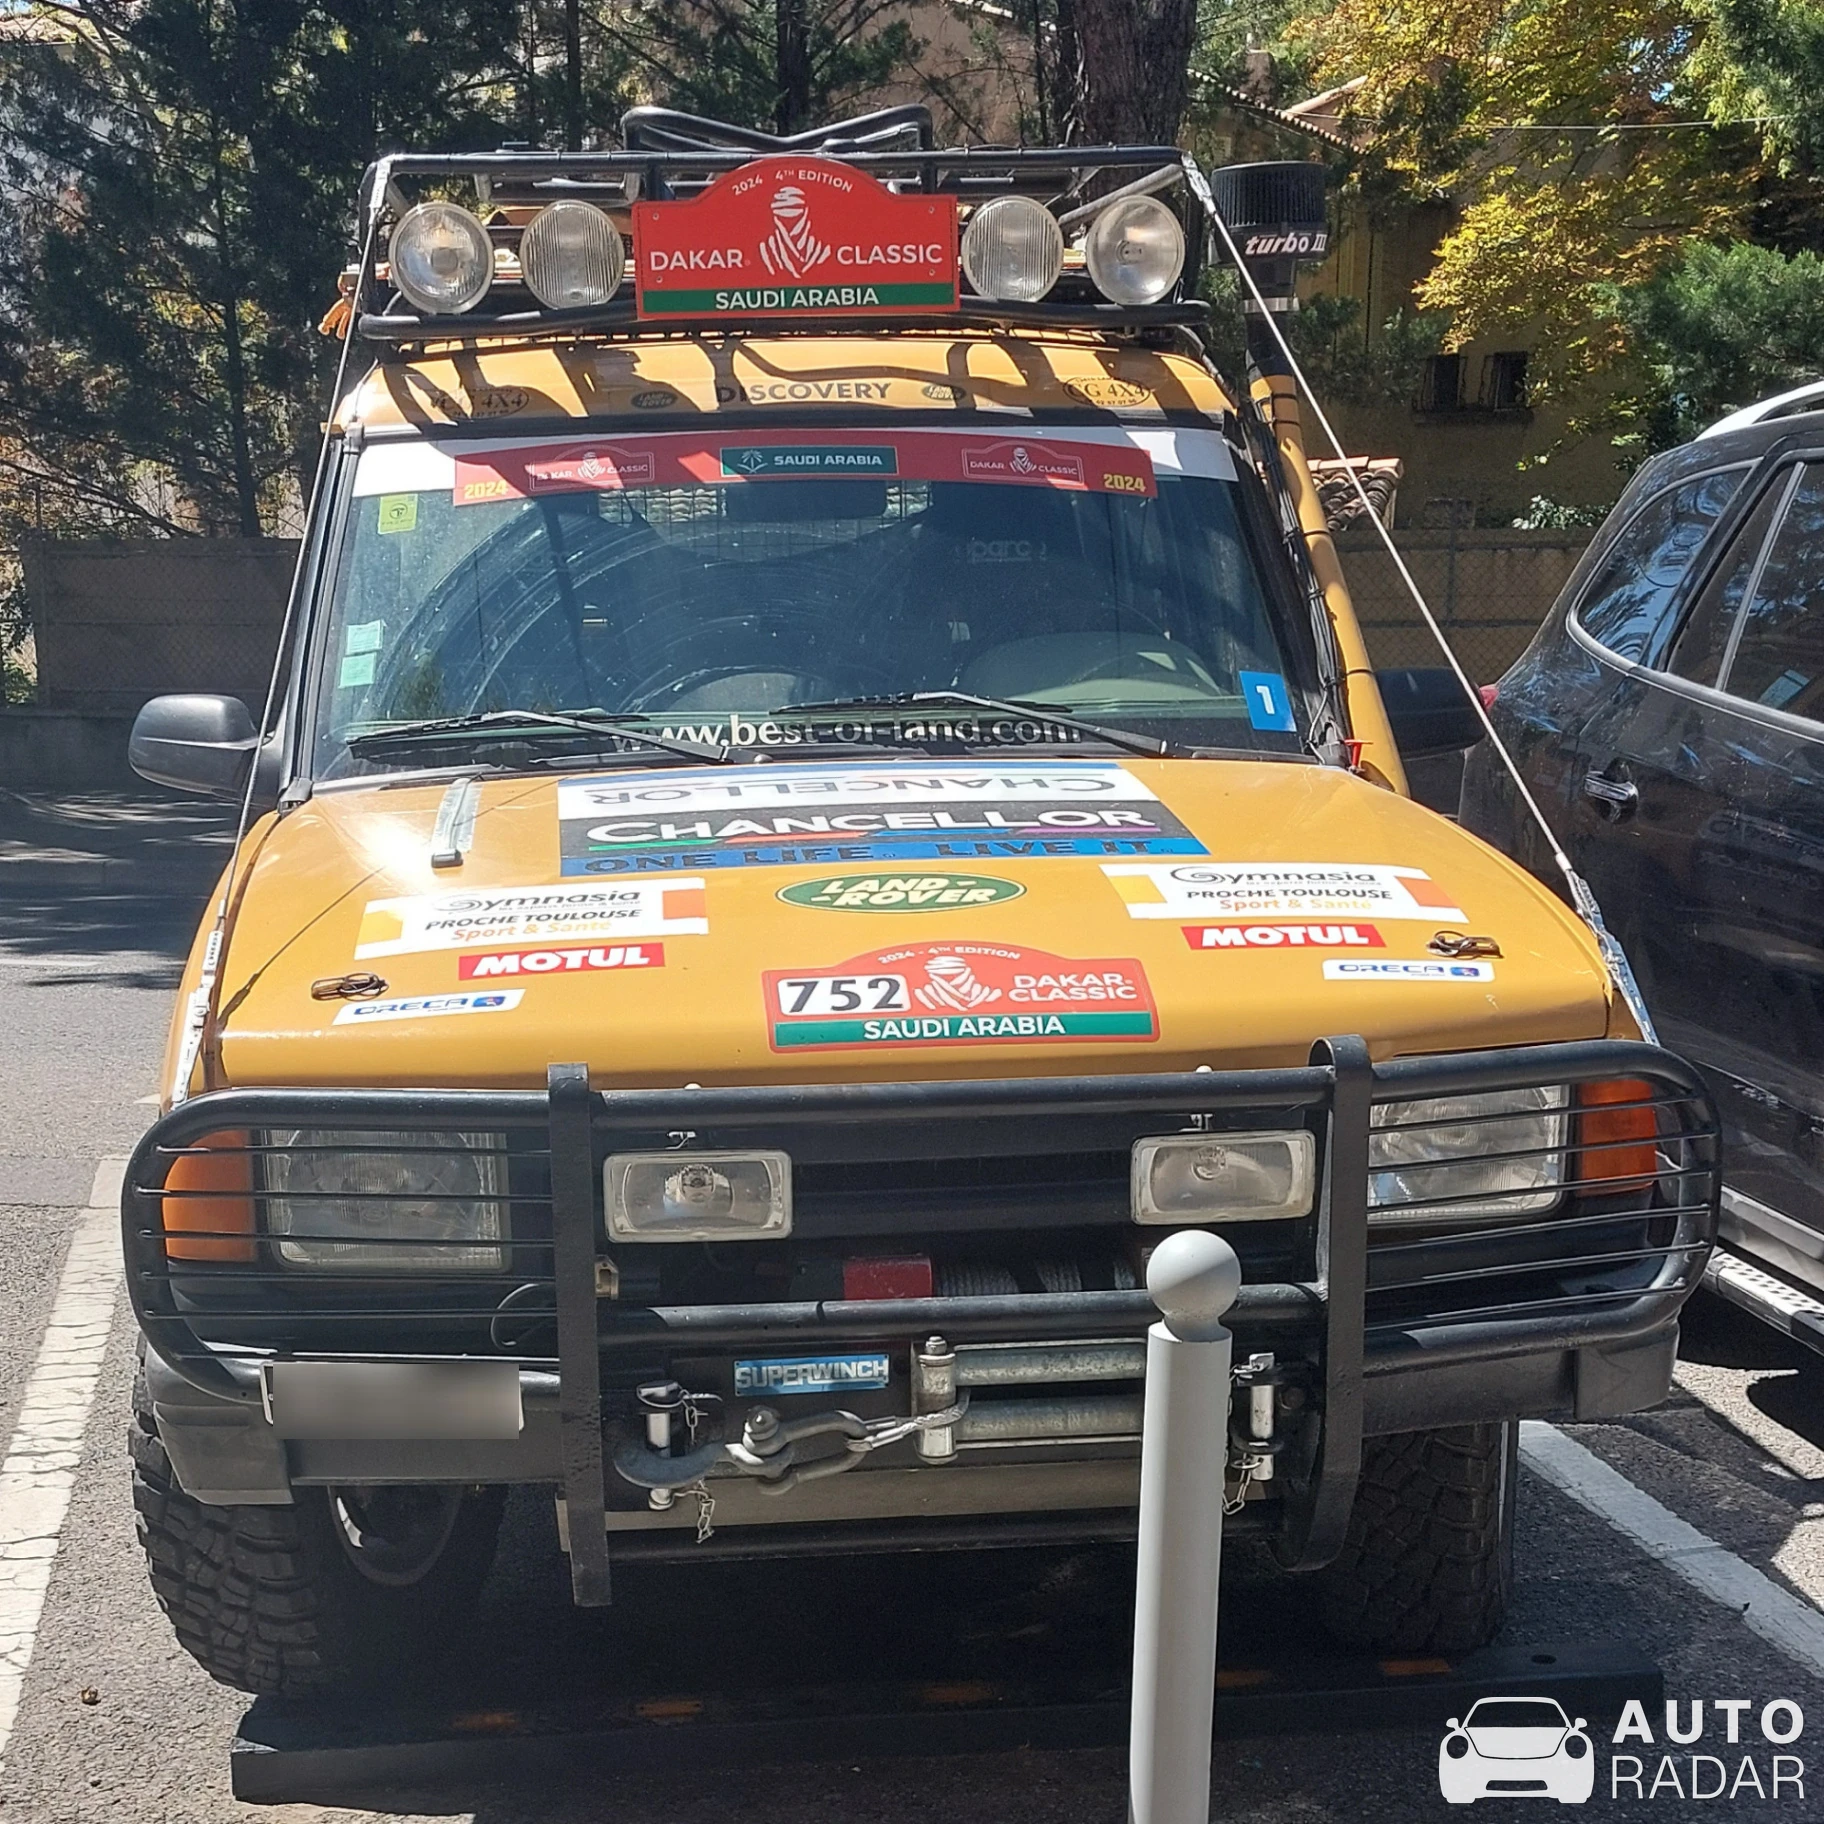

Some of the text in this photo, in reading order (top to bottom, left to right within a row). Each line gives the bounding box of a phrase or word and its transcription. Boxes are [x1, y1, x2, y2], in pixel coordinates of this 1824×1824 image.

[732, 174, 764, 195] 2024
[798, 169, 854, 194] EDITION
[1245, 231, 1309, 256] turbo
[650, 249, 744, 272] DAKAR
[837, 244, 943, 266] CLASSIC
[715, 286, 880, 310] SAUDI ARABIA
[716, 382, 892, 403] DISCOVERY
[1107, 383, 1145, 398] 4X4
[607, 464, 649, 475] CLASSIC
[774, 454, 883, 466] SAUDI ARABIA
[969, 460, 1005, 470] DAKAR
[1038, 464, 1078, 476] CLASSIC
[464, 480, 508, 500] 2024
[1103, 472, 1147, 493] 2024
[1255, 685, 1275, 715] 1
[587, 810, 1156, 843] CHANCELLOR
[585, 853, 717, 873] ONE
[936, 841, 1080, 857] LIVE
[1170, 866, 1377, 885] Gymnasia
[1187, 888, 1393, 900] PROCHE TOULOUSE
[1220, 899, 1280, 912] Sport
[1287, 899, 1302, 909] &
[425, 909, 643, 930] PROCHE TOULOUSE
[452, 926, 516, 942] Sport
[522, 924, 540, 935] &
[1201, 925, 1371, 949] MOTUL
[472, 946, 651, 977] MOTUL
[878, 951, 915, 964] 2024
[955, 946, 1021, 960] EDITION
[1338, 964, 1445, 974] ORECA
[1013, 973, 1125, 988] DAKAR
[786, 977, 905, 1014] 752
[1008, 985, 1138, 1003] CLASSIC
[354, 998, 468, 1016] ORECA
[863, 1013, 1067, 1040] SAUDI ARABIA
[735, 1360, 890, 1389] SUPERWINCH
